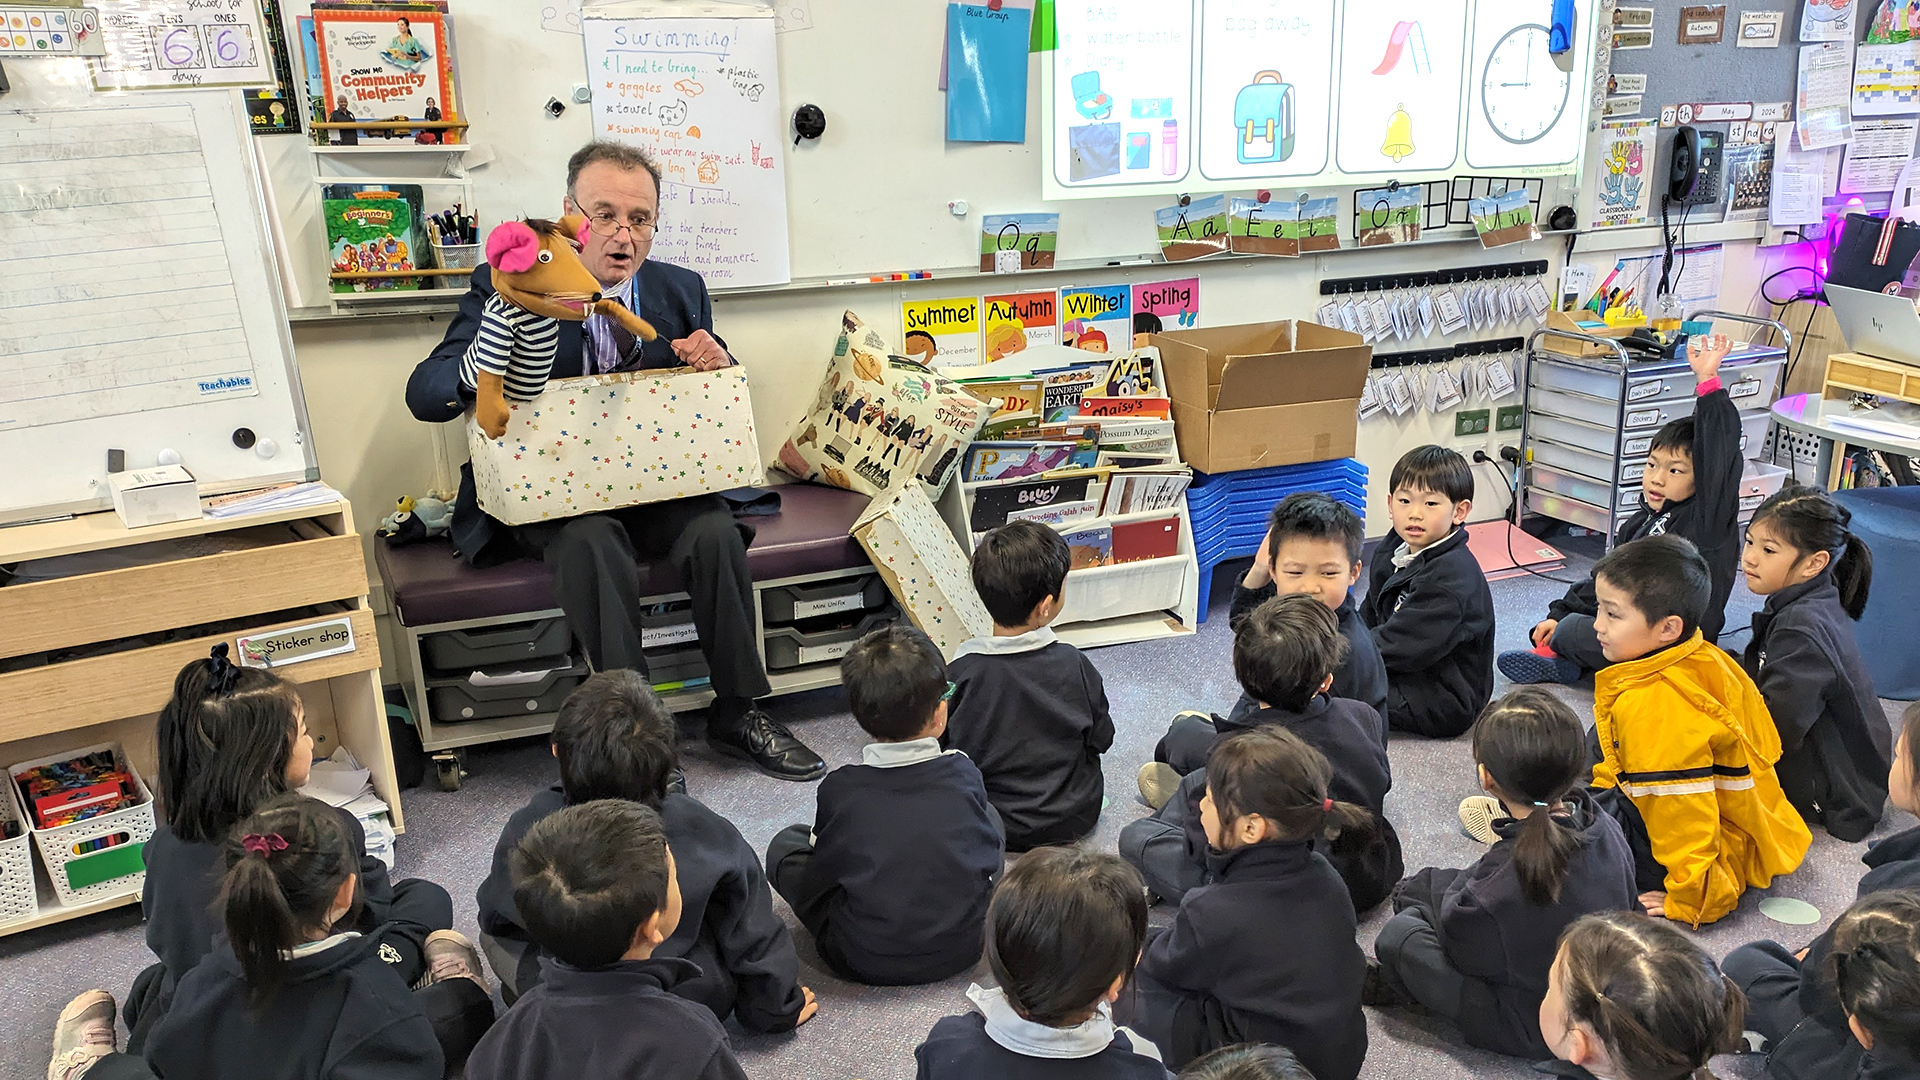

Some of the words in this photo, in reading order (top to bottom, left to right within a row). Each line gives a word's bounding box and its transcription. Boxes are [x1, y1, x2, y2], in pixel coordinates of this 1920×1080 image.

[214, 14, 237, 23] ONES
[966, 7, 983, 18] Blue
[1087, 7, 1117, 21] BAG
[69, 10, 98, 34] 60
[1226, 15, 1257, 39] bag
[1265, 17, 1310, 36] away
[1087, 31, 1133, 44] Water
[1138, 29, 1181, 43] bottle
[1623, 35, 1650, 44] Swimming
[1756, 27, 1772, 36] cloudy
[163, 29, 193, 65] 6
[217, 30, 239, 61] 6
[614, 26, 739, 62] Swimming!
[625, 60, 648, 74] need
[652, 59, 663, 72] to
[1087, 53, 1124, 71] Diary
[172, 69, 202, 86] days
[341, 72, 426, 87] Community
[727, 66, 760, 80] plastic
[356, 85, 414, 103] Helpers
[619, 82, 661, 99] goggles
[732, 78, 748, 96] bag
[616, 102, 652, 115] towel
[1664, 111, 1675, 122] 27
[1680, 107, 1690, 119] th
[1722, 108, 1735, 118] May
[1761, 108, 1776, 116] 2024
[616, 125, 660, 142] swimming
[664, 129, 682, 147] cap
[1616, 128, 1640, 137] HANDY
[1732, 126, 1742, 136] st
[1747, 126, 1759, 137] nd
[1764, 123, 1774, 134] rd
[660, 147, 682, 156] wear
[685, 150, 697, 165] my
[700, 151, 722, 162] swim
[668, 159, 685, 182] bag
[1371, 199, 1390, 229] O
[1481, 203, 1502, 232] U
[1510, 211, 1525, 227] u
[680, 220, 693, 233] the
[700, 221, 738, 236] teachers
[1171, 213, 1194, 240] A
[1203, 219, 1218, 238] a
[1246, 209, 1263, 238] E
[1274, 223, 1284, 239] e
[655, 235, 673, 247] with
[696, 235, 721, 250] friends
[695, 253, 711, 264] and
[1026, 236, 1040, 266] q
[711, 269, 734, 278] room
[1067, 292, 1125, 315] Winter
[1141, 286, 1191, 310] Spring
[1442, 295, 1455, 317] Isaac
[907, 303, 976, 328] Summer
[988, 298, 1053, 321] Autumn
[1029, 330, 1053, 339] March
[939, 346, 977, 356] December
[198, 377, 252, 391] Teachables
[1735, 387, 1753, 395] Stamps
[935, 407, 970, 435] STYLE
[1100, 430, 1131, 438] Possum
[1134, 427, 1160, 438] Magic
[975, 451, 999, 476] P
[1028, 511, 1058, 521] Tweeting
[1059, 506, 1077, 516] Galah
[812, 602, 825, 610] Mini
[827, 600, 846, 609] Unifix
[265, 636, 315, 653] Sticker
[319, 630, 349, 643] shop
